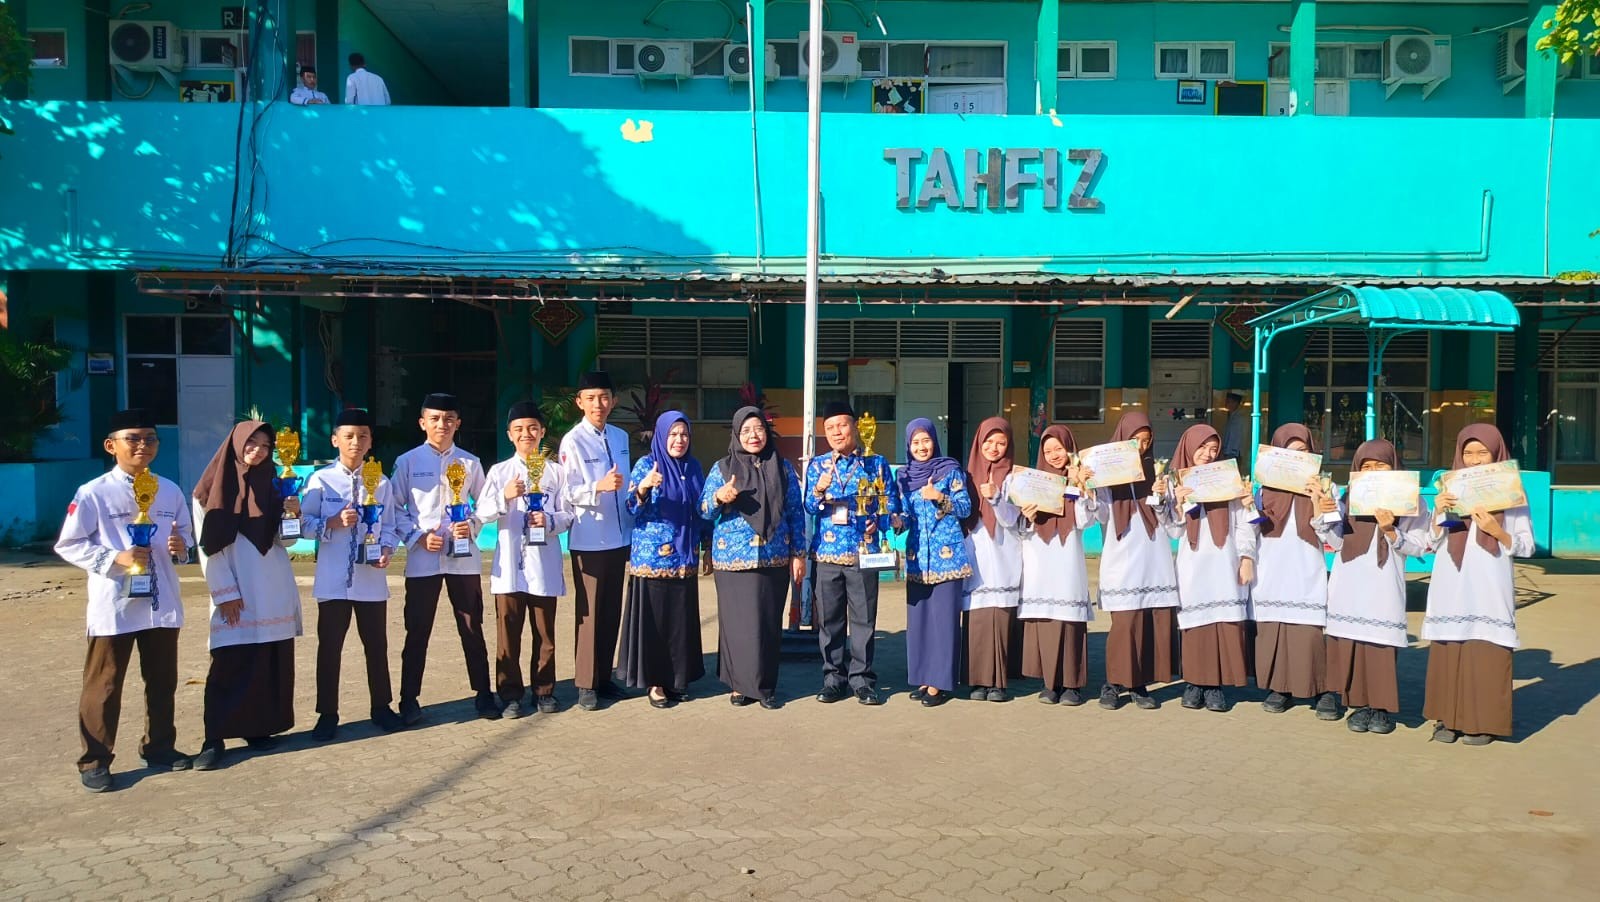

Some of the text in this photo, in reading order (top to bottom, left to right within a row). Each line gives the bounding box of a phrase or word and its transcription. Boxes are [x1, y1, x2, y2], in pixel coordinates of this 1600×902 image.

[223, 11, 234, 26] R
[953, 102, 959, 110] 9
[969, 102, 975, 110] 5
[883, 148, 1102, 209] TAHFIZ
